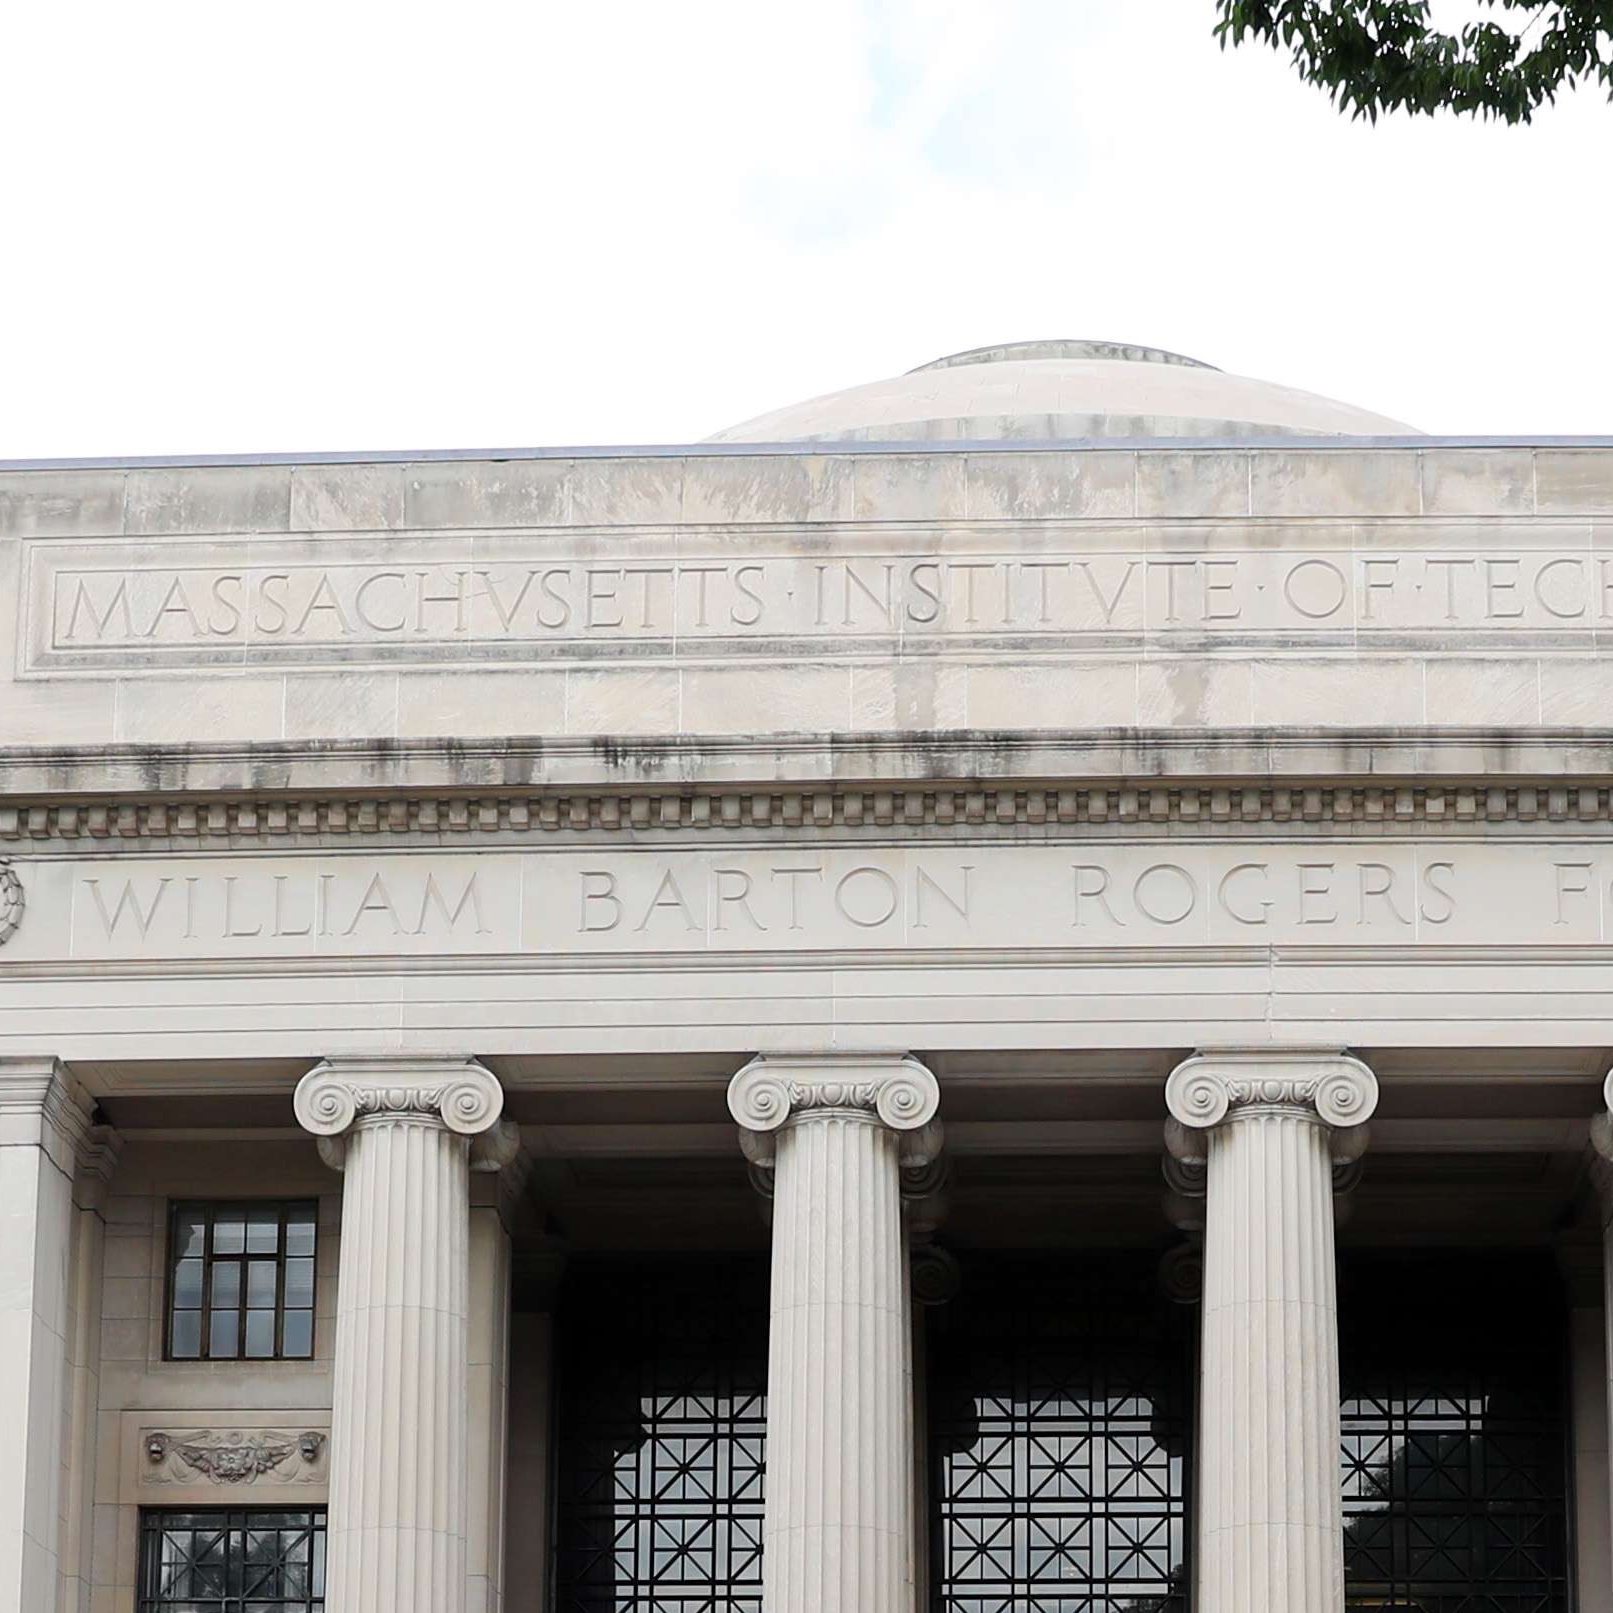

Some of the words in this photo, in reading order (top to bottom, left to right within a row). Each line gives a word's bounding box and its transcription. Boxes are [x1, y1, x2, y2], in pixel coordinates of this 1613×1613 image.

[64, 564, 765, 640] MASSACHVSETTS
[811, 556, 1241, 624] INSTITVTE
[1284, 556, 1403, 620] OF
[83, 871, 491, 940] WILLIAM
[578, 865, 975, 934] BARTON
[1070, 862, 1457, 927] ROGERS
